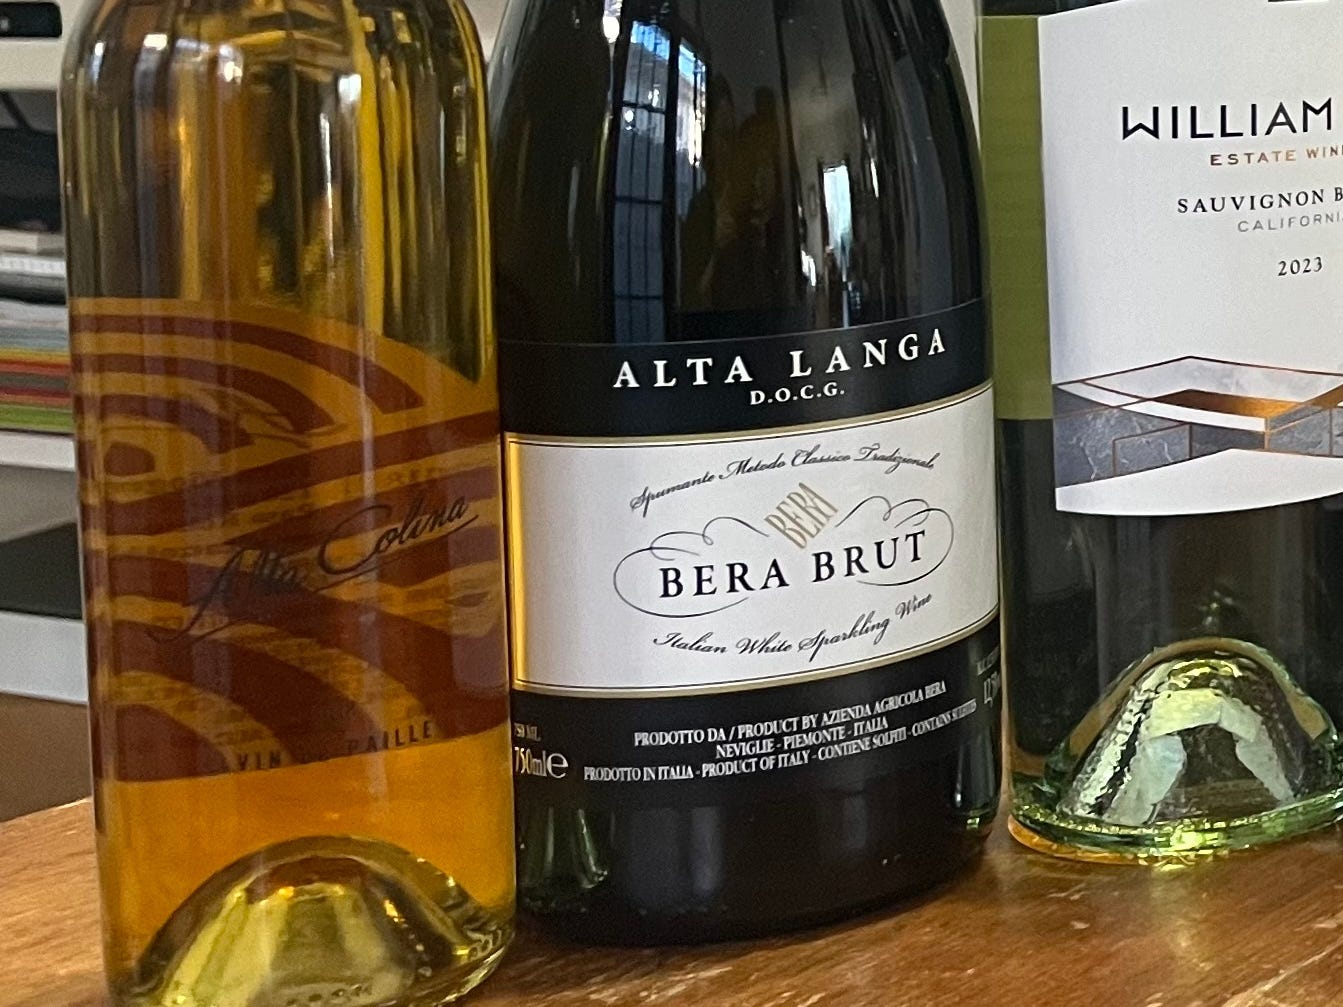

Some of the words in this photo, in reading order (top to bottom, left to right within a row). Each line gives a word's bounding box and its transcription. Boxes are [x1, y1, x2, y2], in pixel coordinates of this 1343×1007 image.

[1122, 97, 1333, 140] WILLIAM
[1210, 149, 1297, 166] ESTATE
[1177, 188, 1325, 214] SAUVIGNON
[1277, 256, 1324, 277] 2023
[613, 355, 752, 389] ALTA
[790, 328, 946, 378] LANGA
[750, 384, 846, 406] D.O.C.G.
[629, 472, 715, 518] Spumante
[719, 452, 786, 480] Metodo
[791, 444, 851, 467] Classico
[853, 442, 941, 474] Tradizionale
[317, 494, 472, 575] Colina
[763, 482, 840, 549] BERA
[659, 558, 790, 598] BERA
[811, 529, 926, 583] BRUT
[653, 631, 728, 654] Italian
[736, 631, 792, 654] White
[797, 611, 891, 663] Sparkling
[895, 593, 932, 619] Wine
[634, 729, 704, 747] PRODOTTO
[707, 727, 726, 742] DA
[738, 716, 799, 739] PRODUCT
[801, 713, 819, 730] BY
[821, 703, 872, 726] AZIENDA
[873, 689, 923, 714] AGRICOLA
[925, 680, 947, 699] BERA
[715, 737, 775, 759] NEVIGLIE
[783, 725, 847, 750] PIEMONTE
[853, 716, 889, 737] ITALIA
[237, 749, 281, 770] VIN
[345, 719, 434, 756] PAILLE
[584, 766, 641, 782] PRODOTTO
[643, 766, 656, 781] IN
[657, 765, 694, 781] ITALIA
[702, 757, 759, 779] PRODUCT
[759, 754, 776, 771] OF
[777, 749, 811, 769] ITALY
[817, 737, 871, 761] CONTIENE
